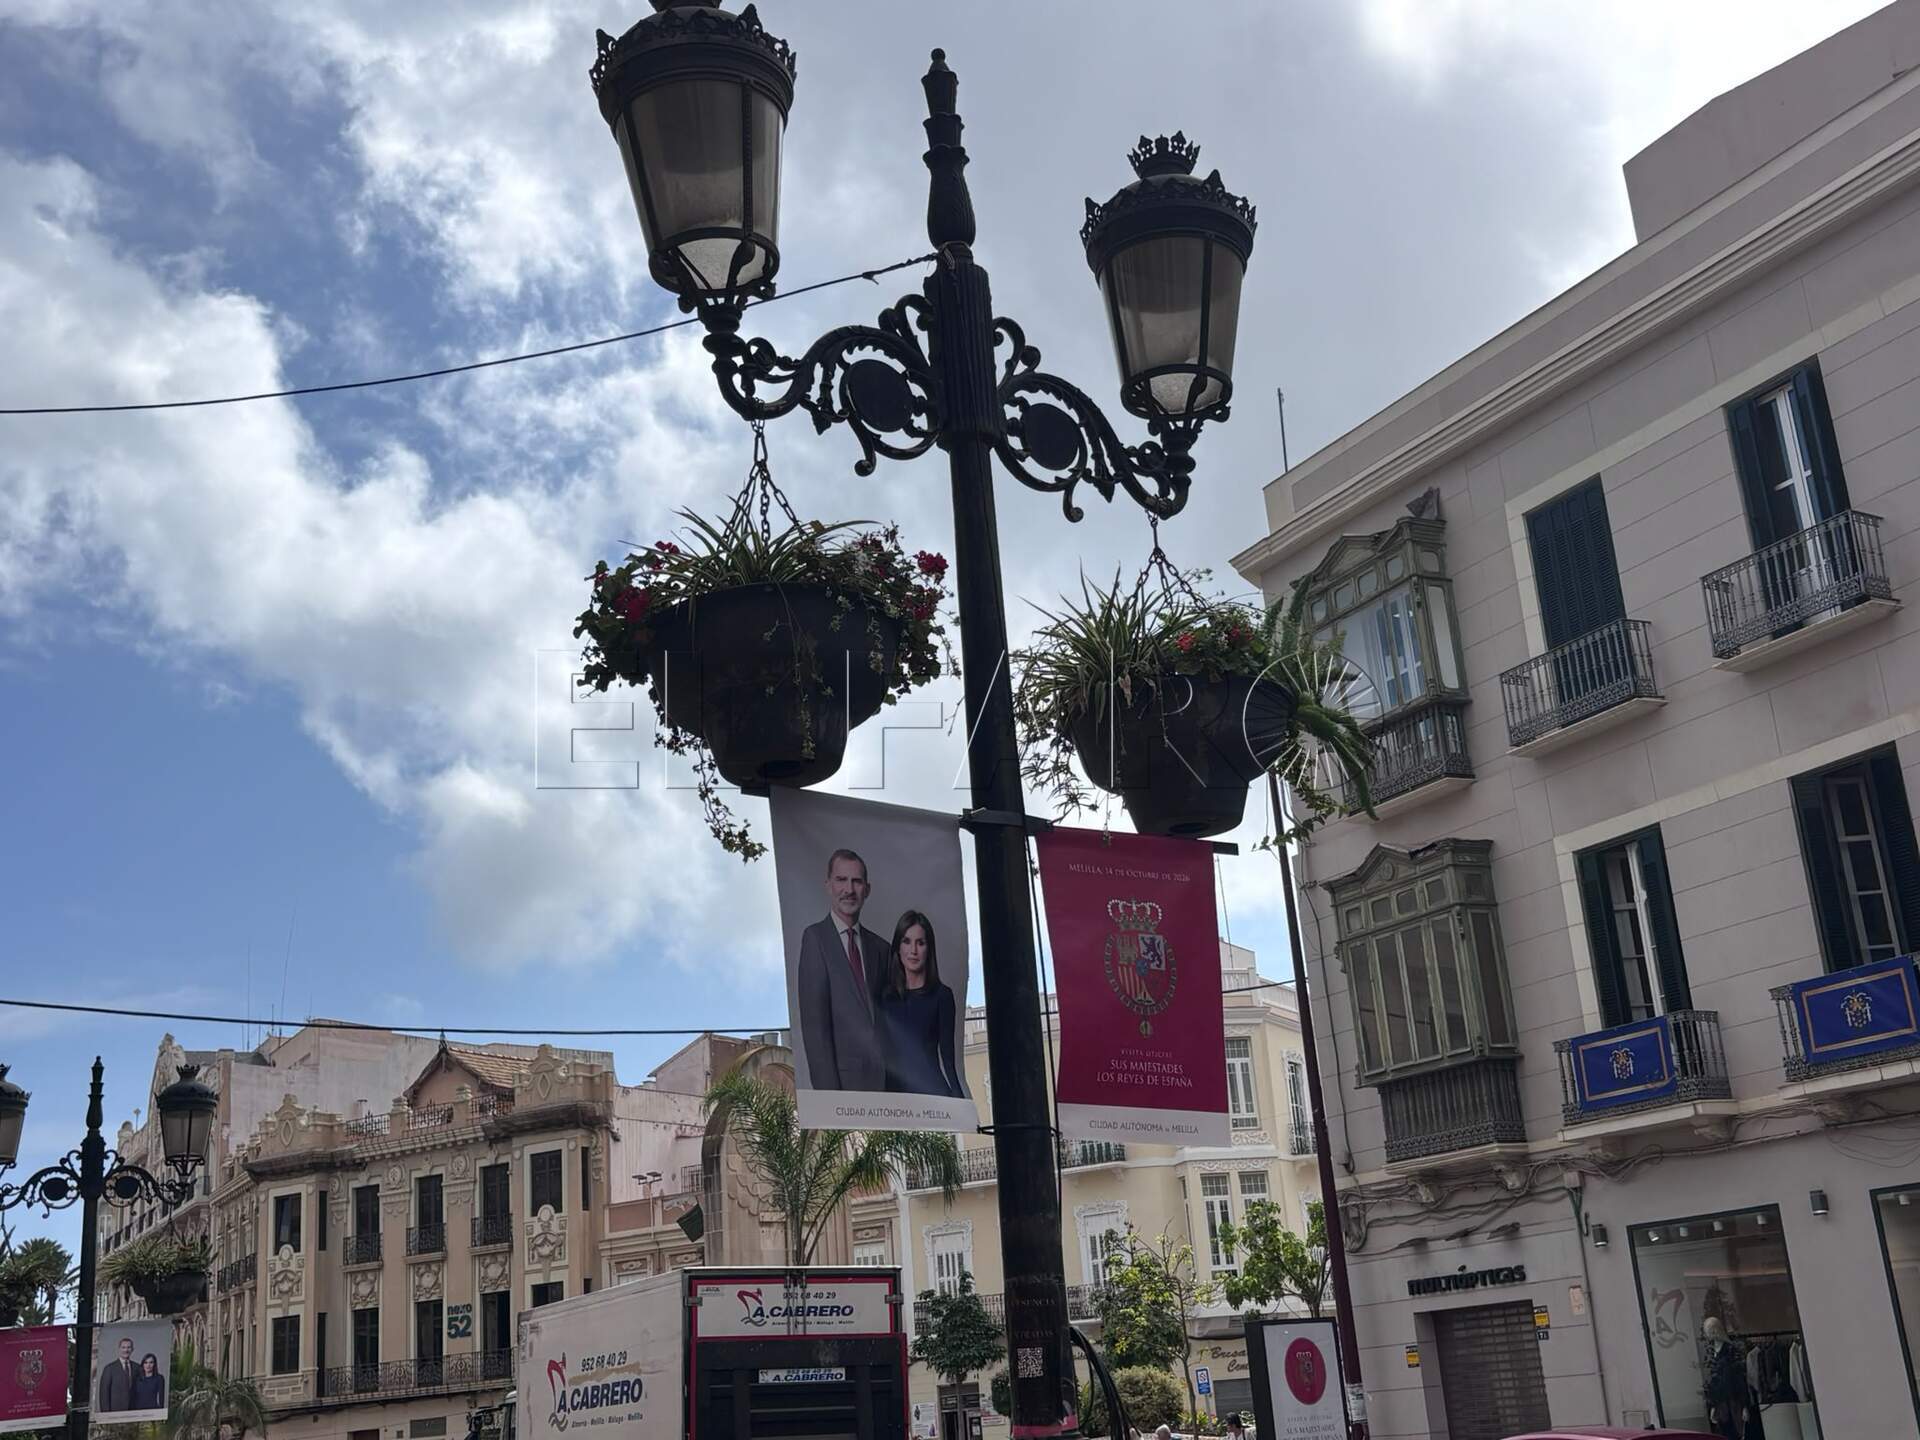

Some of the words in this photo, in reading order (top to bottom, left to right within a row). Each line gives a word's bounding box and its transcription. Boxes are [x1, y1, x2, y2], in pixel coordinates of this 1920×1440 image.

[1115, 868, 1125, 878] DE
[1126, 869, 1159, 880] OCTUBRE
[1110, 1059, 1127, 1071] SUS
[1129, 1061, 1184, 1074] MAJESTADES
[1097, 1072, 1115, 1082] LOS
[1117, 1073, 1144, 1084] REYES
[1147, 1075, 1159, 1085] DE
[1161, 1075, 1193, 1088] ESPAÑA
[835, 1106, 865, 1117] CIUDAD
[868, 1107, 914, 1118] AUTÓNOMA
[922, 1110, 952, 1120] MELILLA
[1089, 1120, 1118, 1130] CIUDAD
[1120, 1121, 1163, 1132] AUTÓNOMA
[1172, 1124, 1199, 1134] MELILLA
[752, 1305, 854, 1319] A.CABRERO
[447, 1314, 472, 1339] 52
[582, 1357, 595, 1372] 952
[596, 1354, 605, 1369] 68
[607, 1353, 616, 1367] 40
[617, 1350, 627, 1365] 29
[772, 1372, 844, 1382] A.CABRERO
[557, 1378, 643, 1414] A.CABRERO
